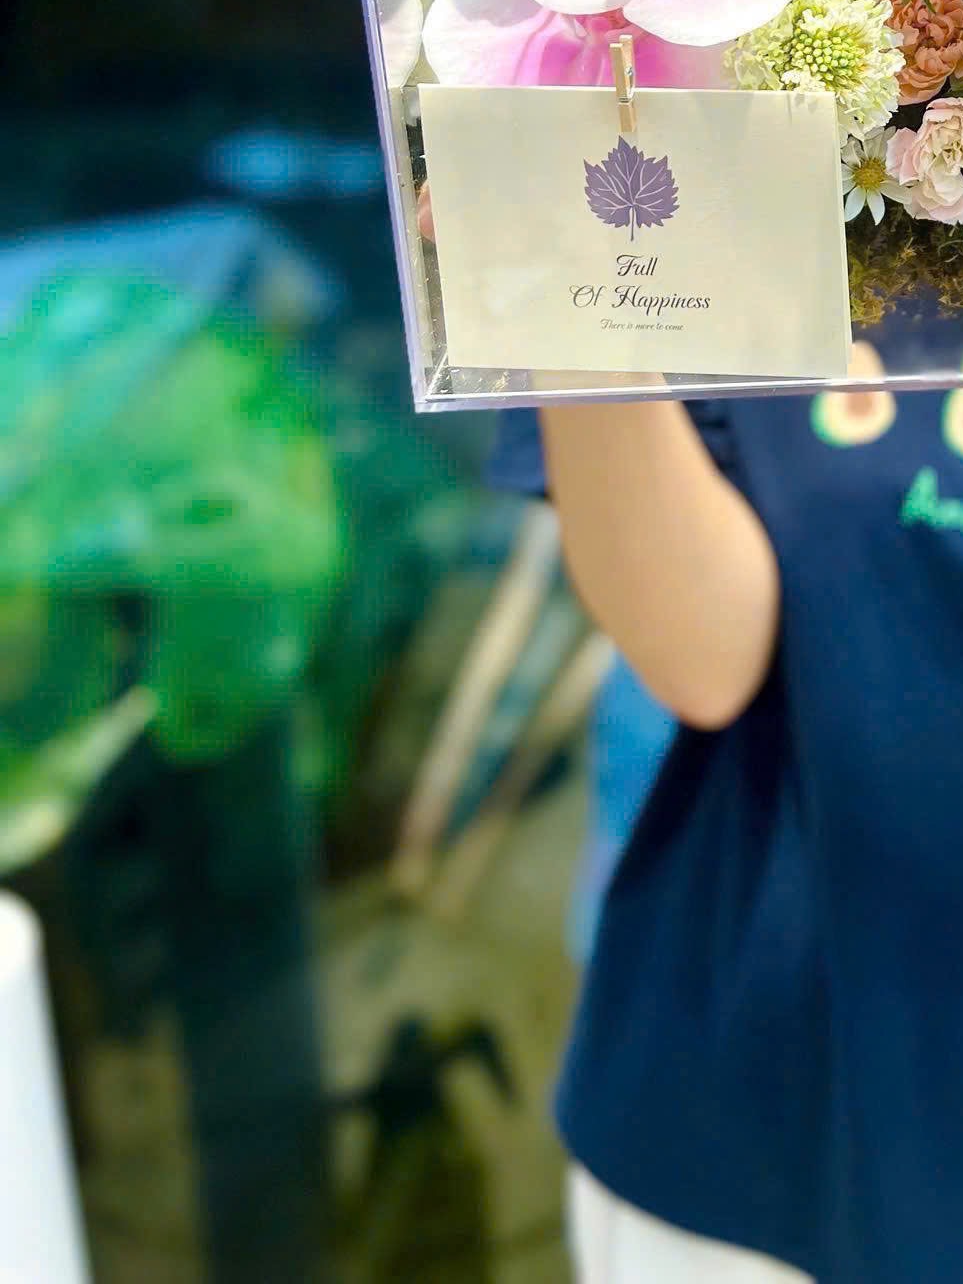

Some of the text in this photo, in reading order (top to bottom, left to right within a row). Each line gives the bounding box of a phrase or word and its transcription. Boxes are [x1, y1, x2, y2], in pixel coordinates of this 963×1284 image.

[616, 254, 659, 277] Full
[569, 284, 711, 316] Of Happiness
[664, 324, 685, 332] come
